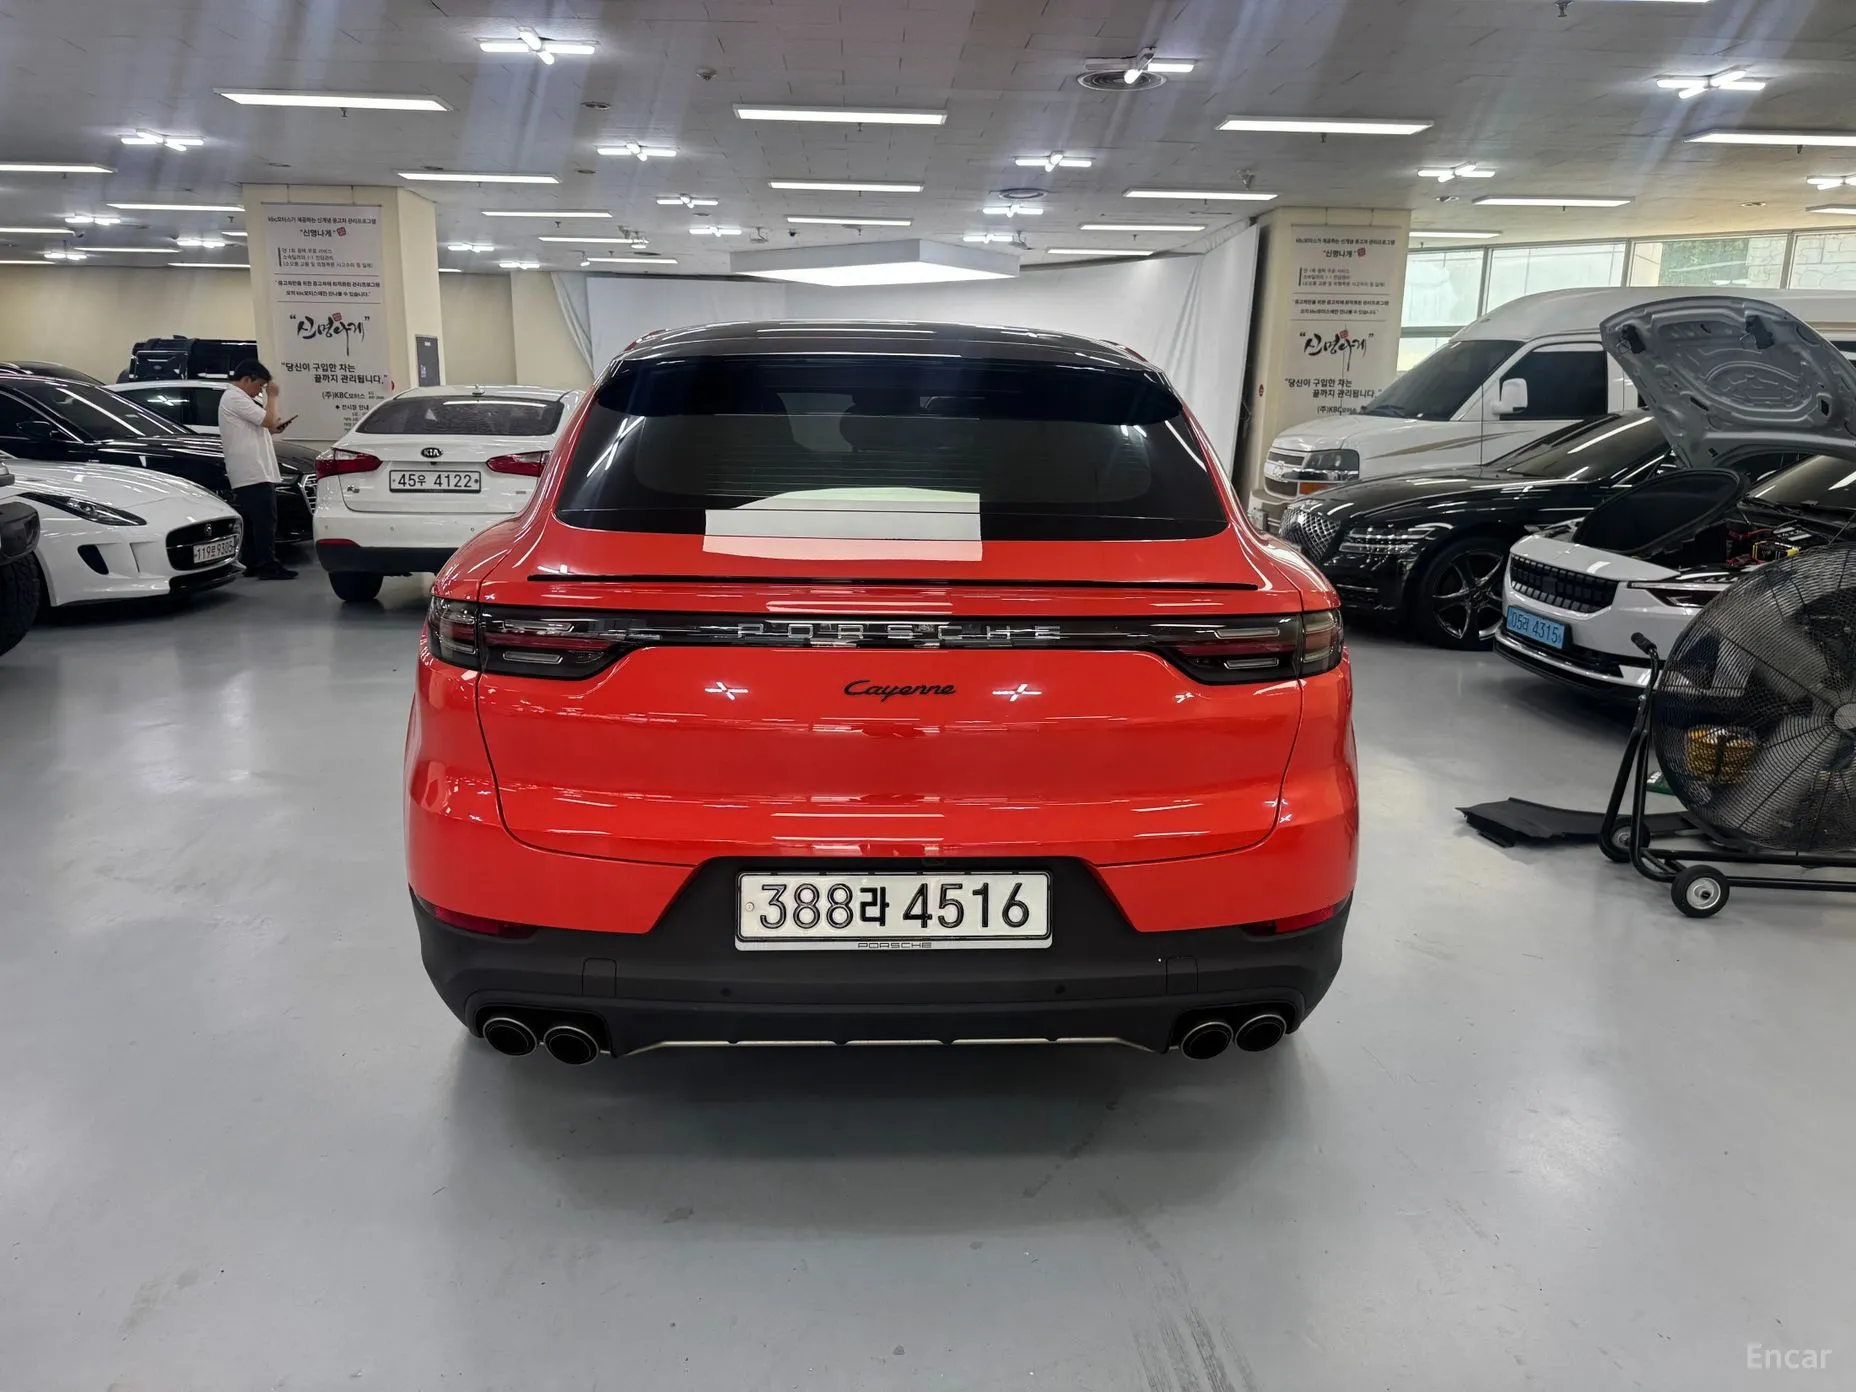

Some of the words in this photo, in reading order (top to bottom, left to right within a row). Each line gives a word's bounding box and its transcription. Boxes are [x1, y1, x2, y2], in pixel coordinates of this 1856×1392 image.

[313, 363, 337, 373] 구입한
[339, 363, 356, 373] 차는
[313, 374, 338, 384] 끝까지
[1312, 378, 1335, 388] 구입한
[1312, 388, 1335, 398] 끝까지
[423, 449, 441, 457] KIA
[397, 473, 427, 488] 45우
[433, 473, 473, 488] 4122
[738, 624, 1061, 641] PORSCHE
[1532, 620, 1560, 643] 4315
[843, 679, 957, 703] Cayenne
[759, 883, 890, 930] 388라
[902, 882, 1030, 929] 4516
